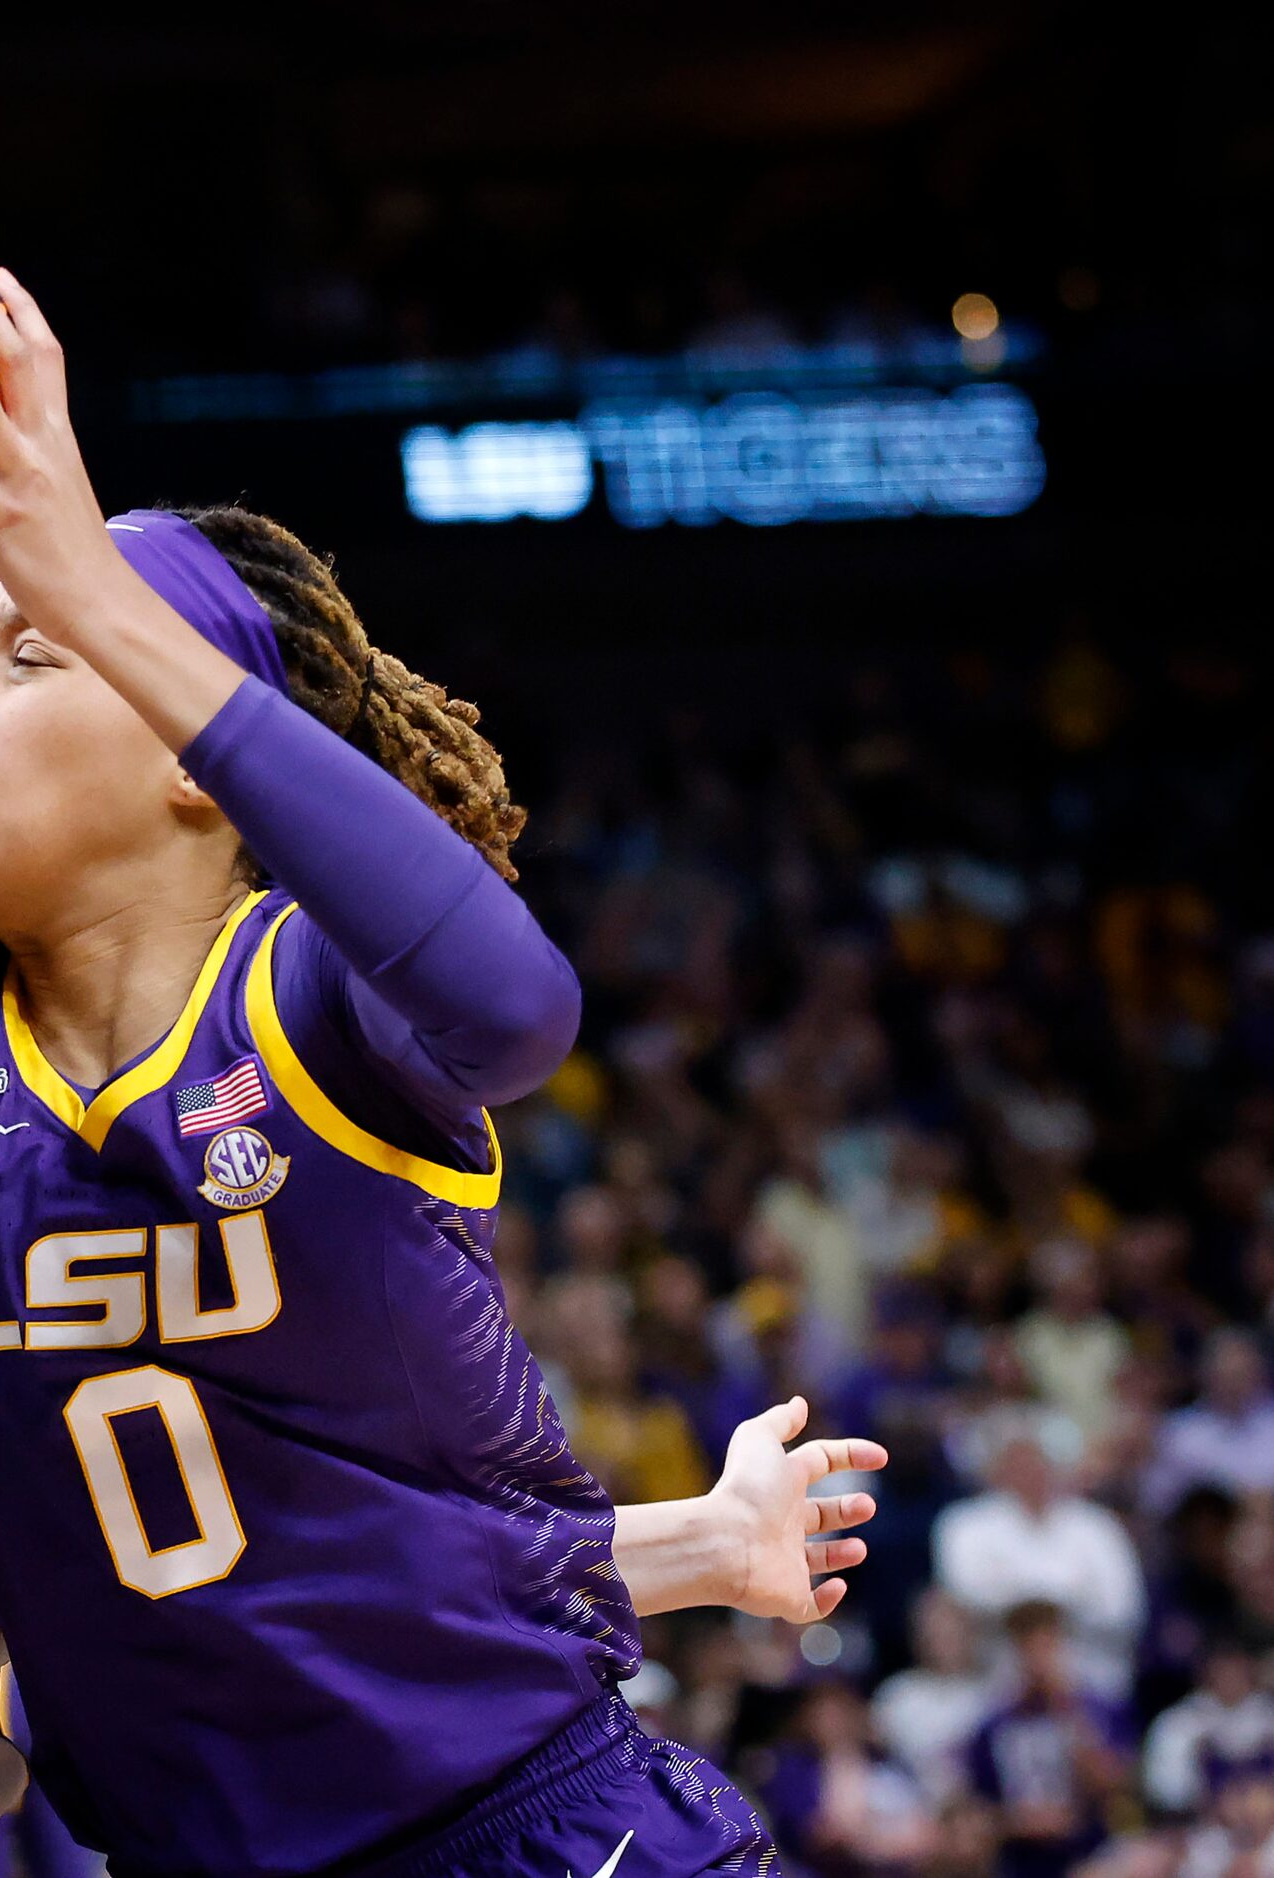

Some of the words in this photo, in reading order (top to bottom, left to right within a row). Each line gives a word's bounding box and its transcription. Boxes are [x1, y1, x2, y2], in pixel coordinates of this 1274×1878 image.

[211, 1131, 267, 1188] SEC
[213, 1173, 282, 1207] GRADUATE
[62, 1364, 248, 1600] 0
